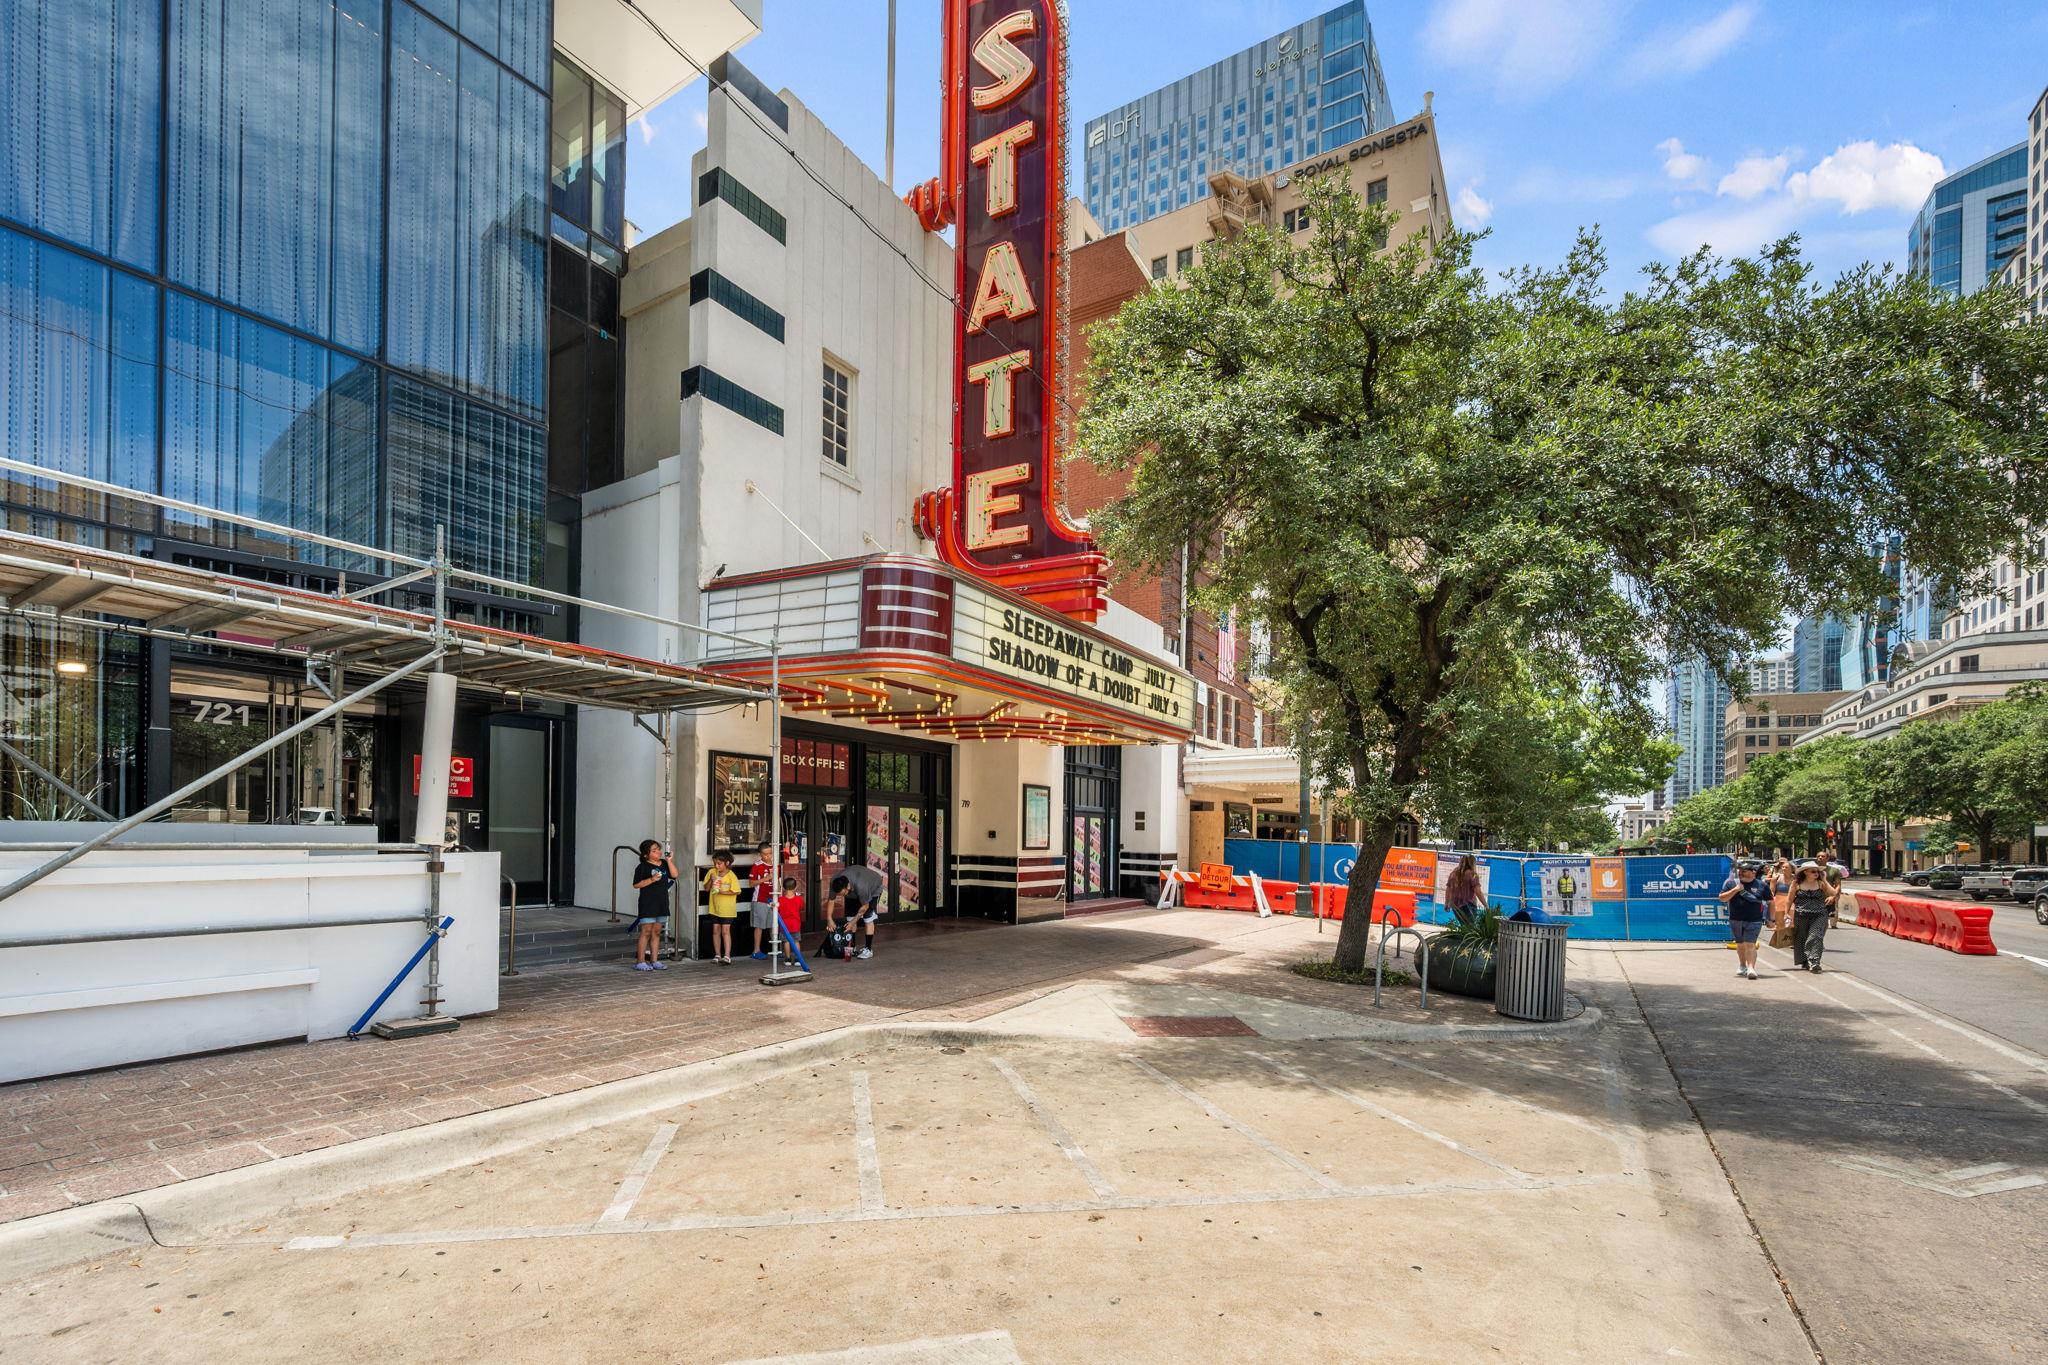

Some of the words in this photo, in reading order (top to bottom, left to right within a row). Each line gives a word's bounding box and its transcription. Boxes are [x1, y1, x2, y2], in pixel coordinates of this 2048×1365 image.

[1255, 42, 1318, 77] element
[1089, 110, 1141, 148] aloft
[1294, 155, 1344, 178] ROYAL
[1349, 122, 1428, 162] SONESTA
[966, 9, 1038, 551] STATE
[1003, 609, 1093, 662] SLEEPAWAY
[1101, 649, 1134, 678] CAMP
[1144, 667, 1166, 690] JULY
[1169, 676, 1176, 694] 7
[989, 636, 1059, 680] SHADOW
[1066, 664, 1084, 687] OF
[1088, 671, 1098, 693] A
[1103, 675, 1141, 706] DOUBT
[1147, 692, 1169, 717] JULY
[1172, 701, 1179, 717] 9
[190, 700, 249, 727] 721
[782, 755, 806, 766] BOX
[808, 757, 845, 770] OFFICE
[723, 790, 760, 805] SHINE
[723, 802, 744, 816] ON
[1202, 874, 1229, 883] DETOUR
